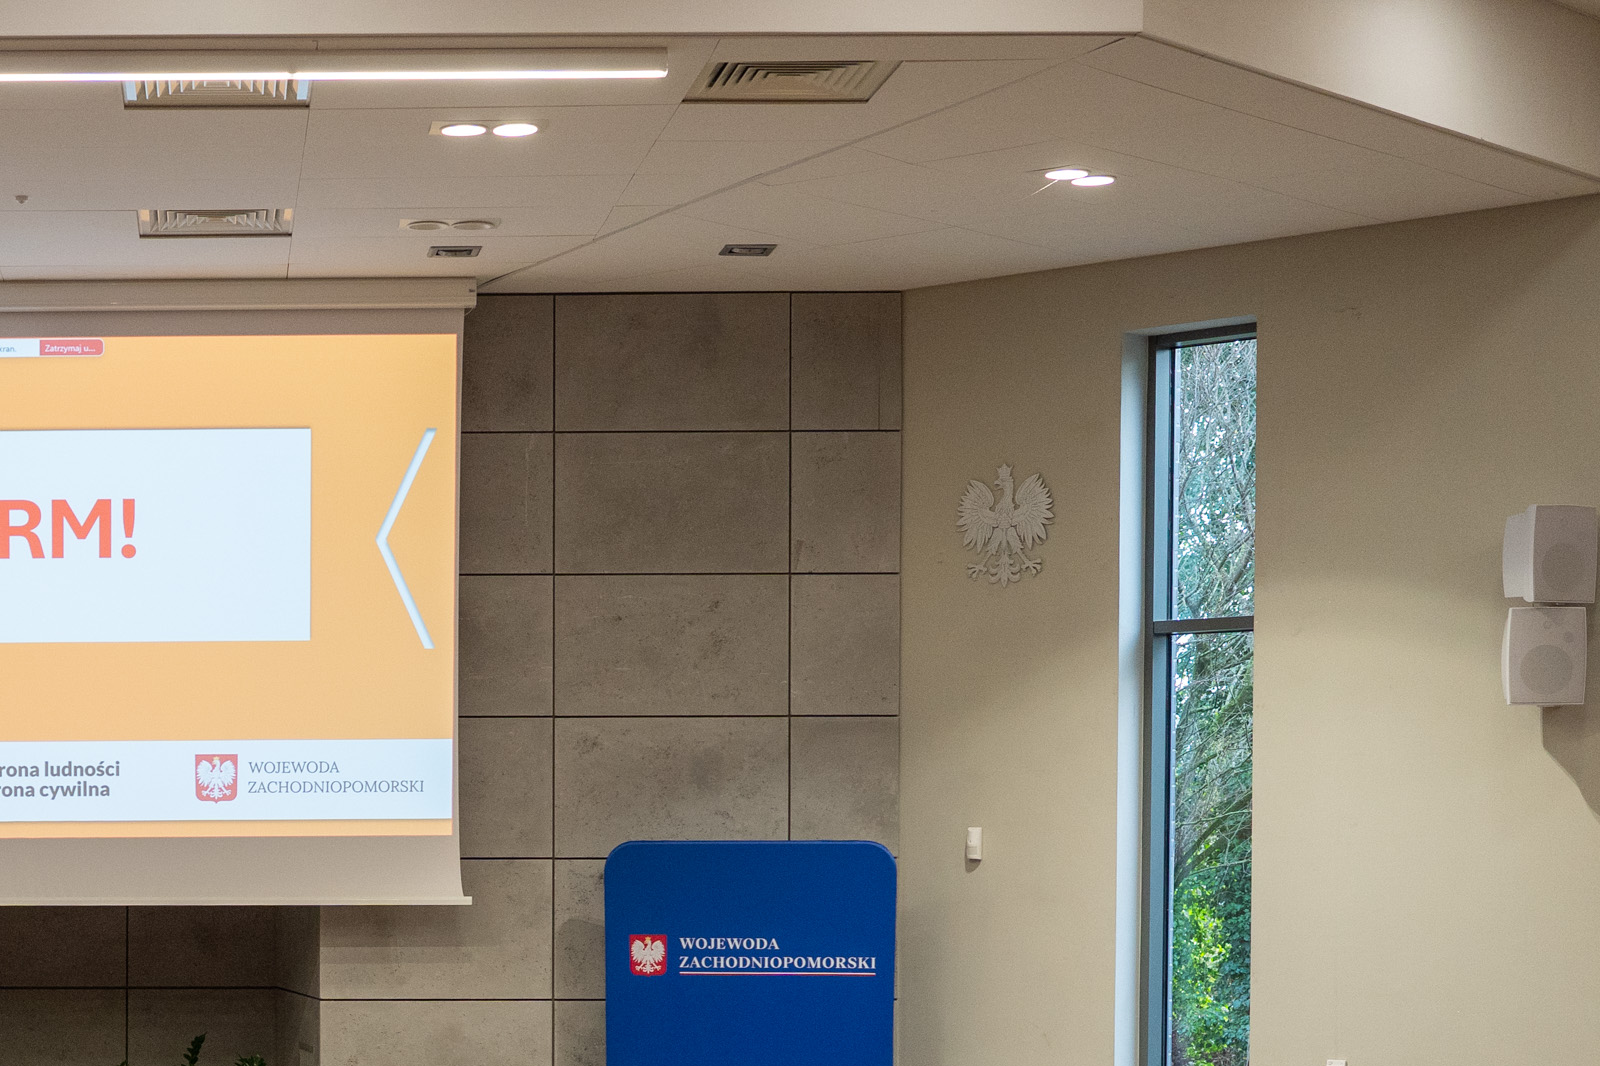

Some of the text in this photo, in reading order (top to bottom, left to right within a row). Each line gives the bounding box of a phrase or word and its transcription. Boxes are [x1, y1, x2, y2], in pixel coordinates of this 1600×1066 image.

[45, 344, 82, 353] Zatrzymaj
[44, 760, 120, 777] ludności
[248, 760, 340, 774] WOJEWODA
[39, 780, 110, 800] cywilna
[248, 780, 424, 793] ZACHODNIOPOMORSKI
[679, 937, 780, 950] WOJEWODA
[679, 956, 876, 969] ZACHODNIOPOMORSKI
